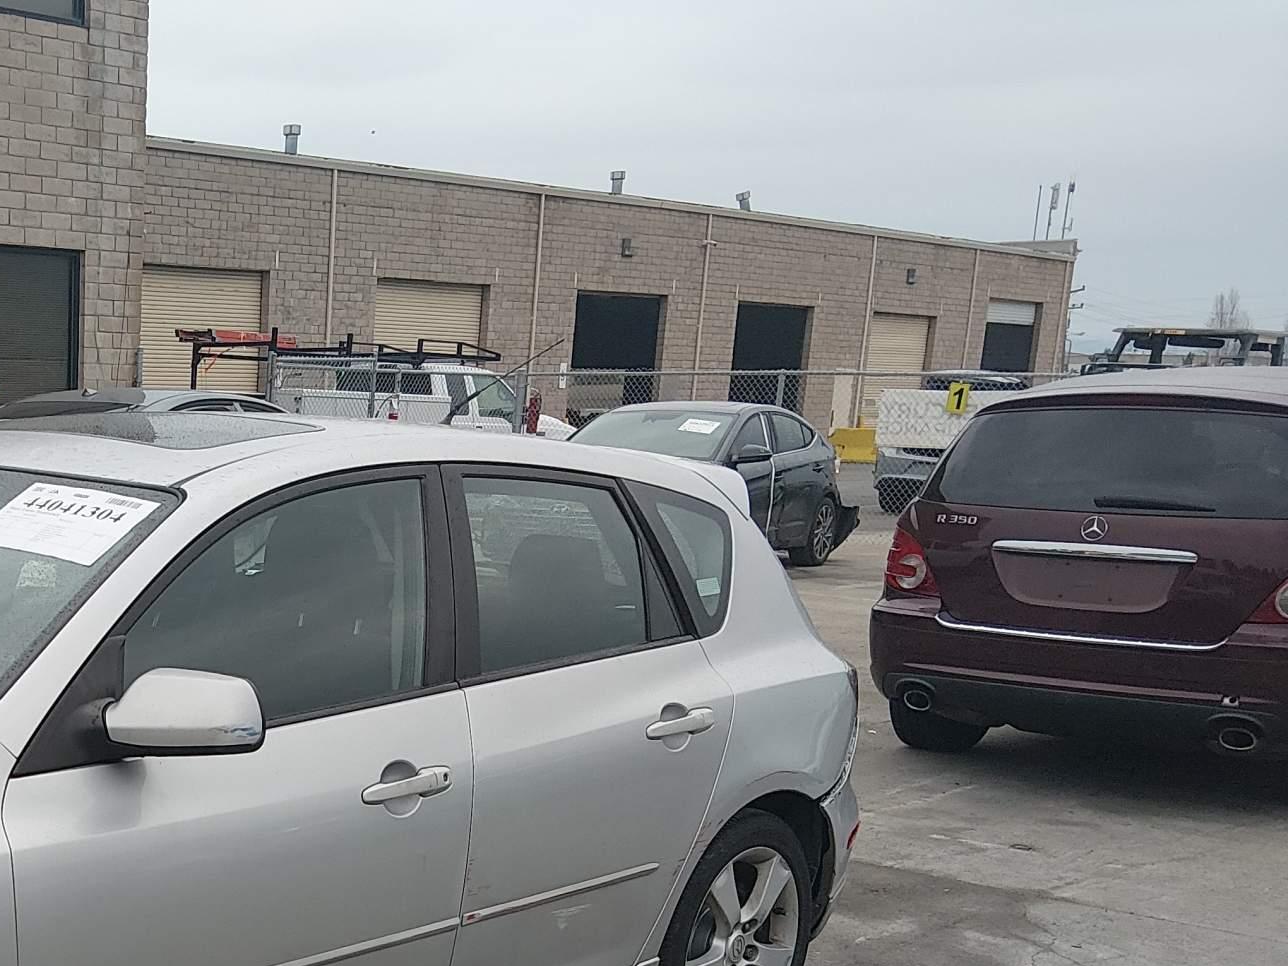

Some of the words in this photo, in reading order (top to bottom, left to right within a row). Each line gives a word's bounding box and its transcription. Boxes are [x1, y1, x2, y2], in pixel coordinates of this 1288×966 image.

[953, 387, 965, 410] 1
[23, 497, 127, 523] 44041304
[936, 513, 948, 524] R
[950, 514, 978, 525] 350
